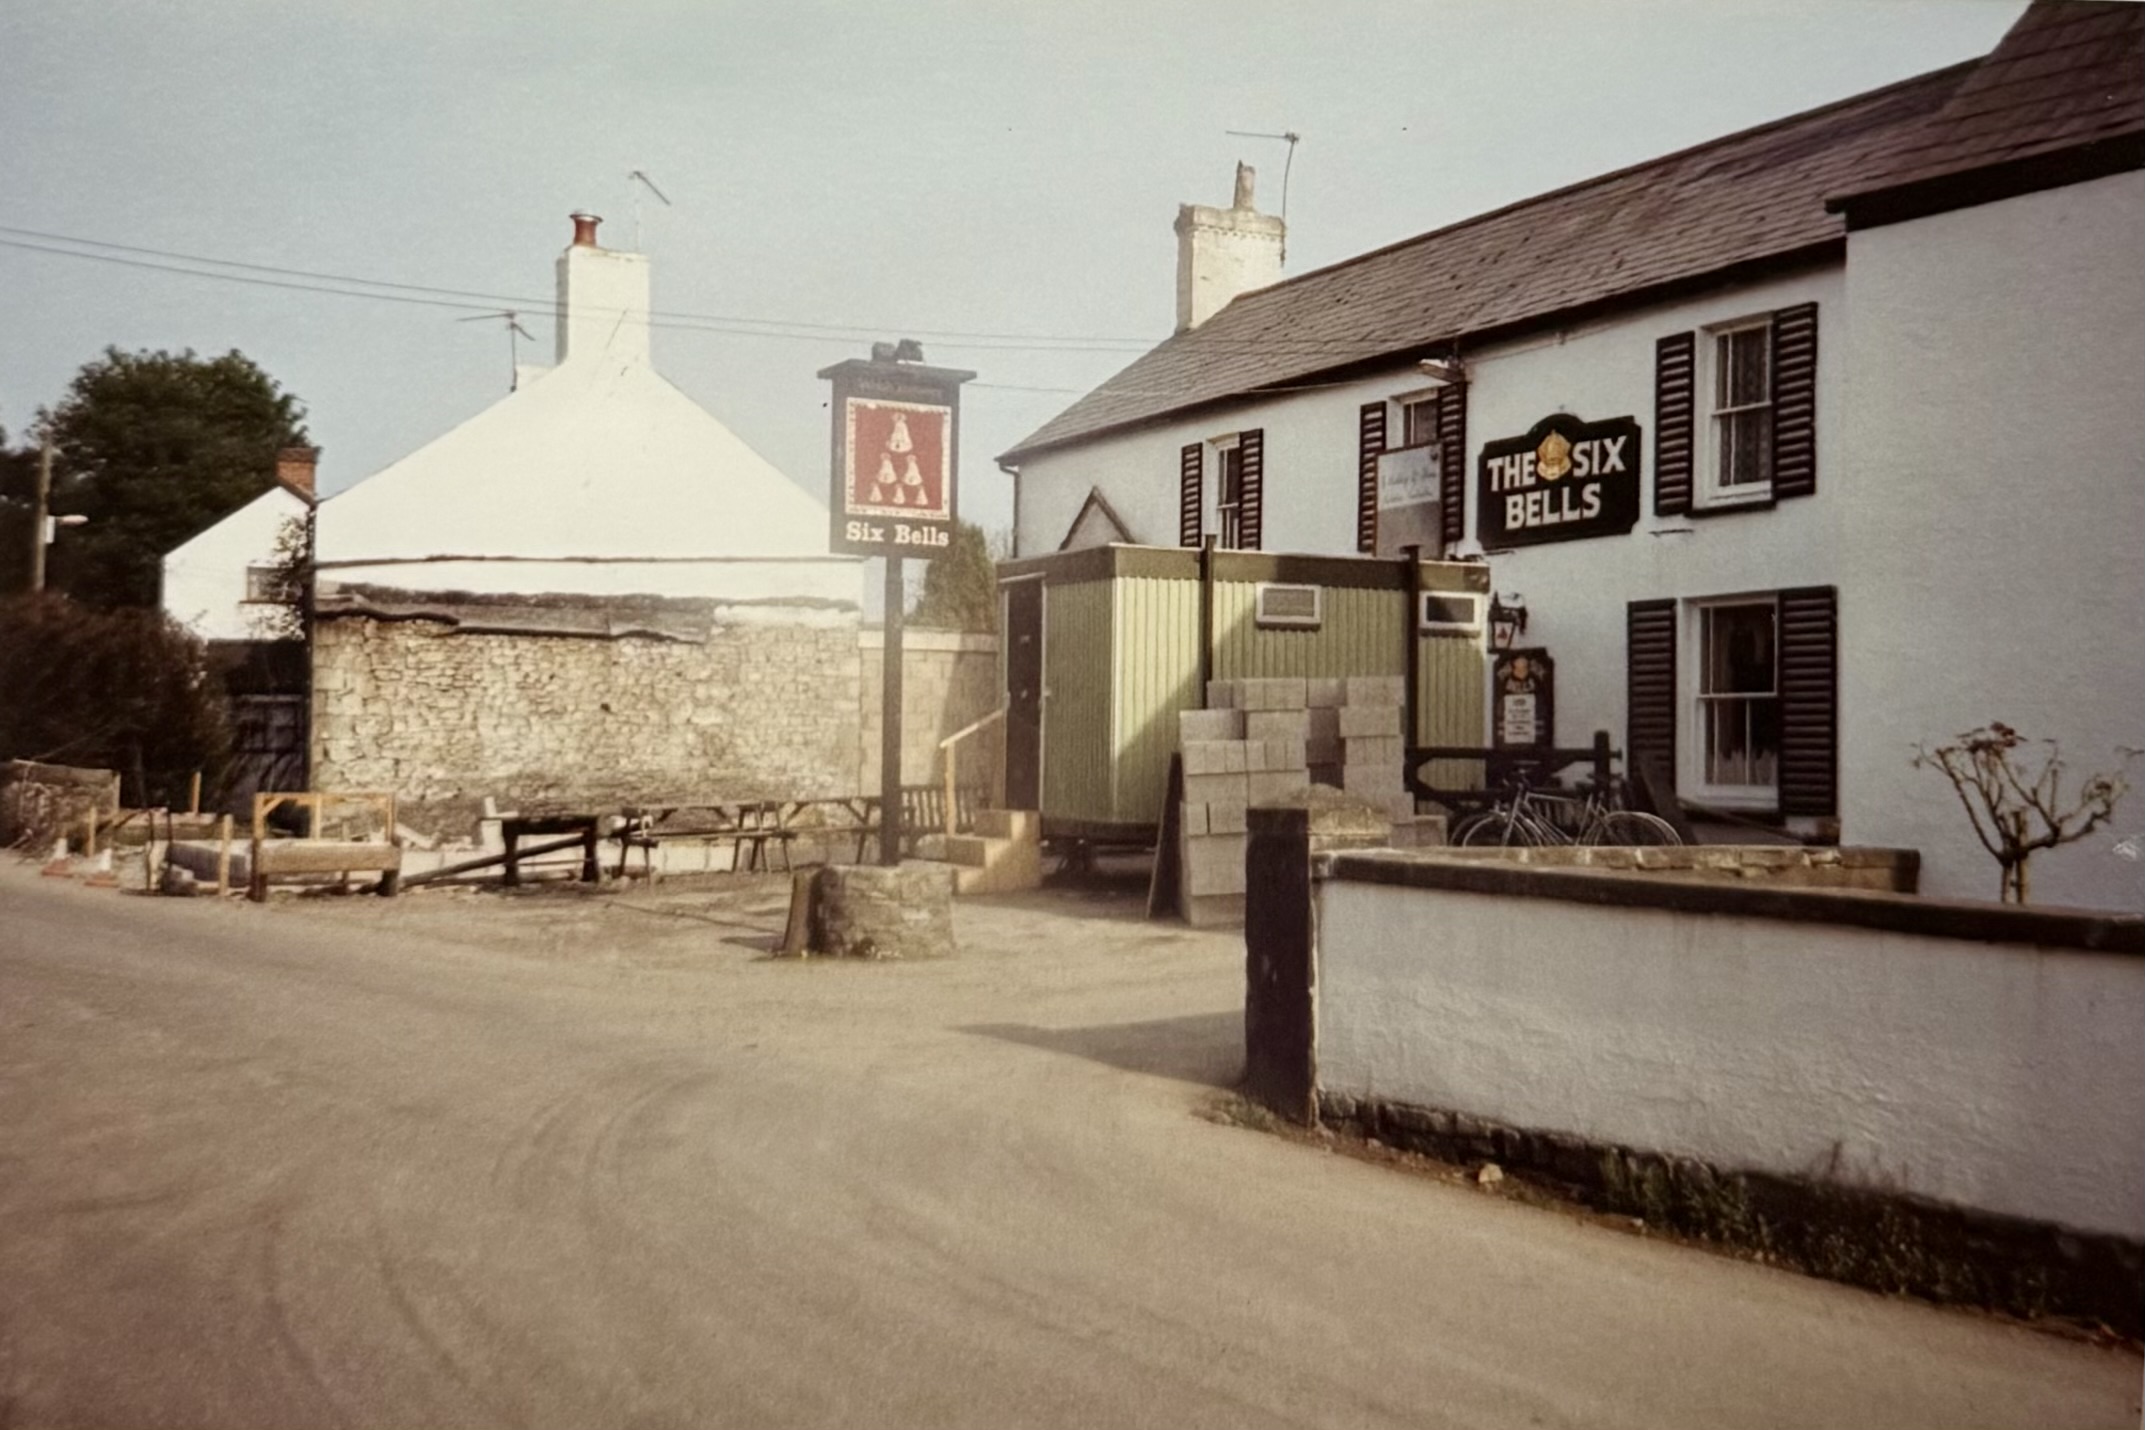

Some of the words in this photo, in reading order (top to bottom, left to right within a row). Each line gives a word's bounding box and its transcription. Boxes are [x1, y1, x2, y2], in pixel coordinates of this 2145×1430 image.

[1487, 450, 1537, 492] THE
[1572, 435, 1627, 477] SIX
[1505, 483, 1601, 530] BELLS
[845, 521, 884, 542] Six
[894, 524, 949, 546] Bells
